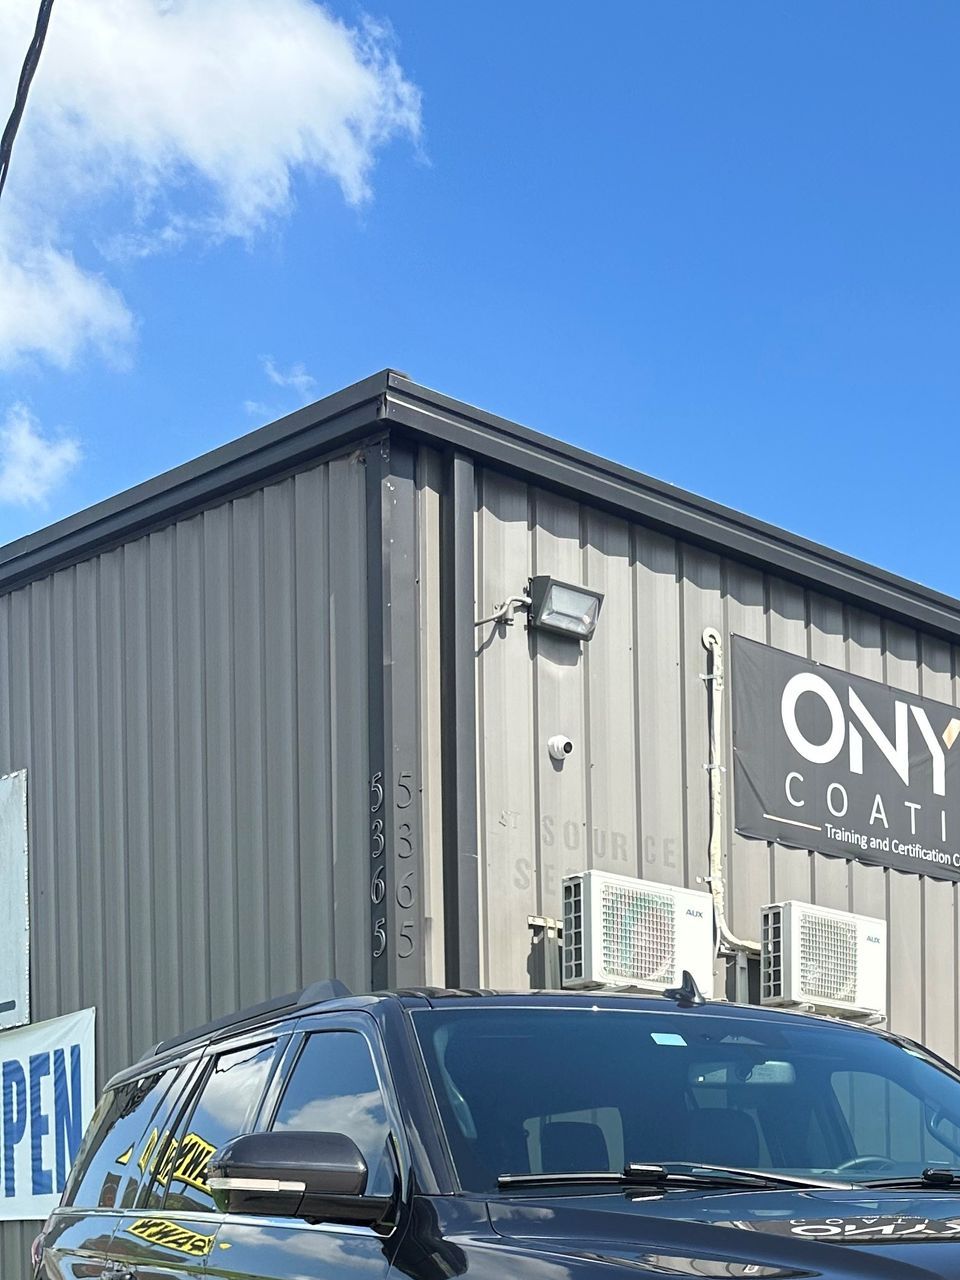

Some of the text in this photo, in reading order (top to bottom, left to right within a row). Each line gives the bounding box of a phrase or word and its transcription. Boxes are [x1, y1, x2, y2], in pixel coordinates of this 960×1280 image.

[371, 771, 387, 958] 5365
[541, 814, 676, 868] SOURCE
[825, 823, 867, 849] Training
[870, 837, 889, 851] and
[891, 840, 951, 865] Certification
[0, 1043, 82, 1198] PEN
